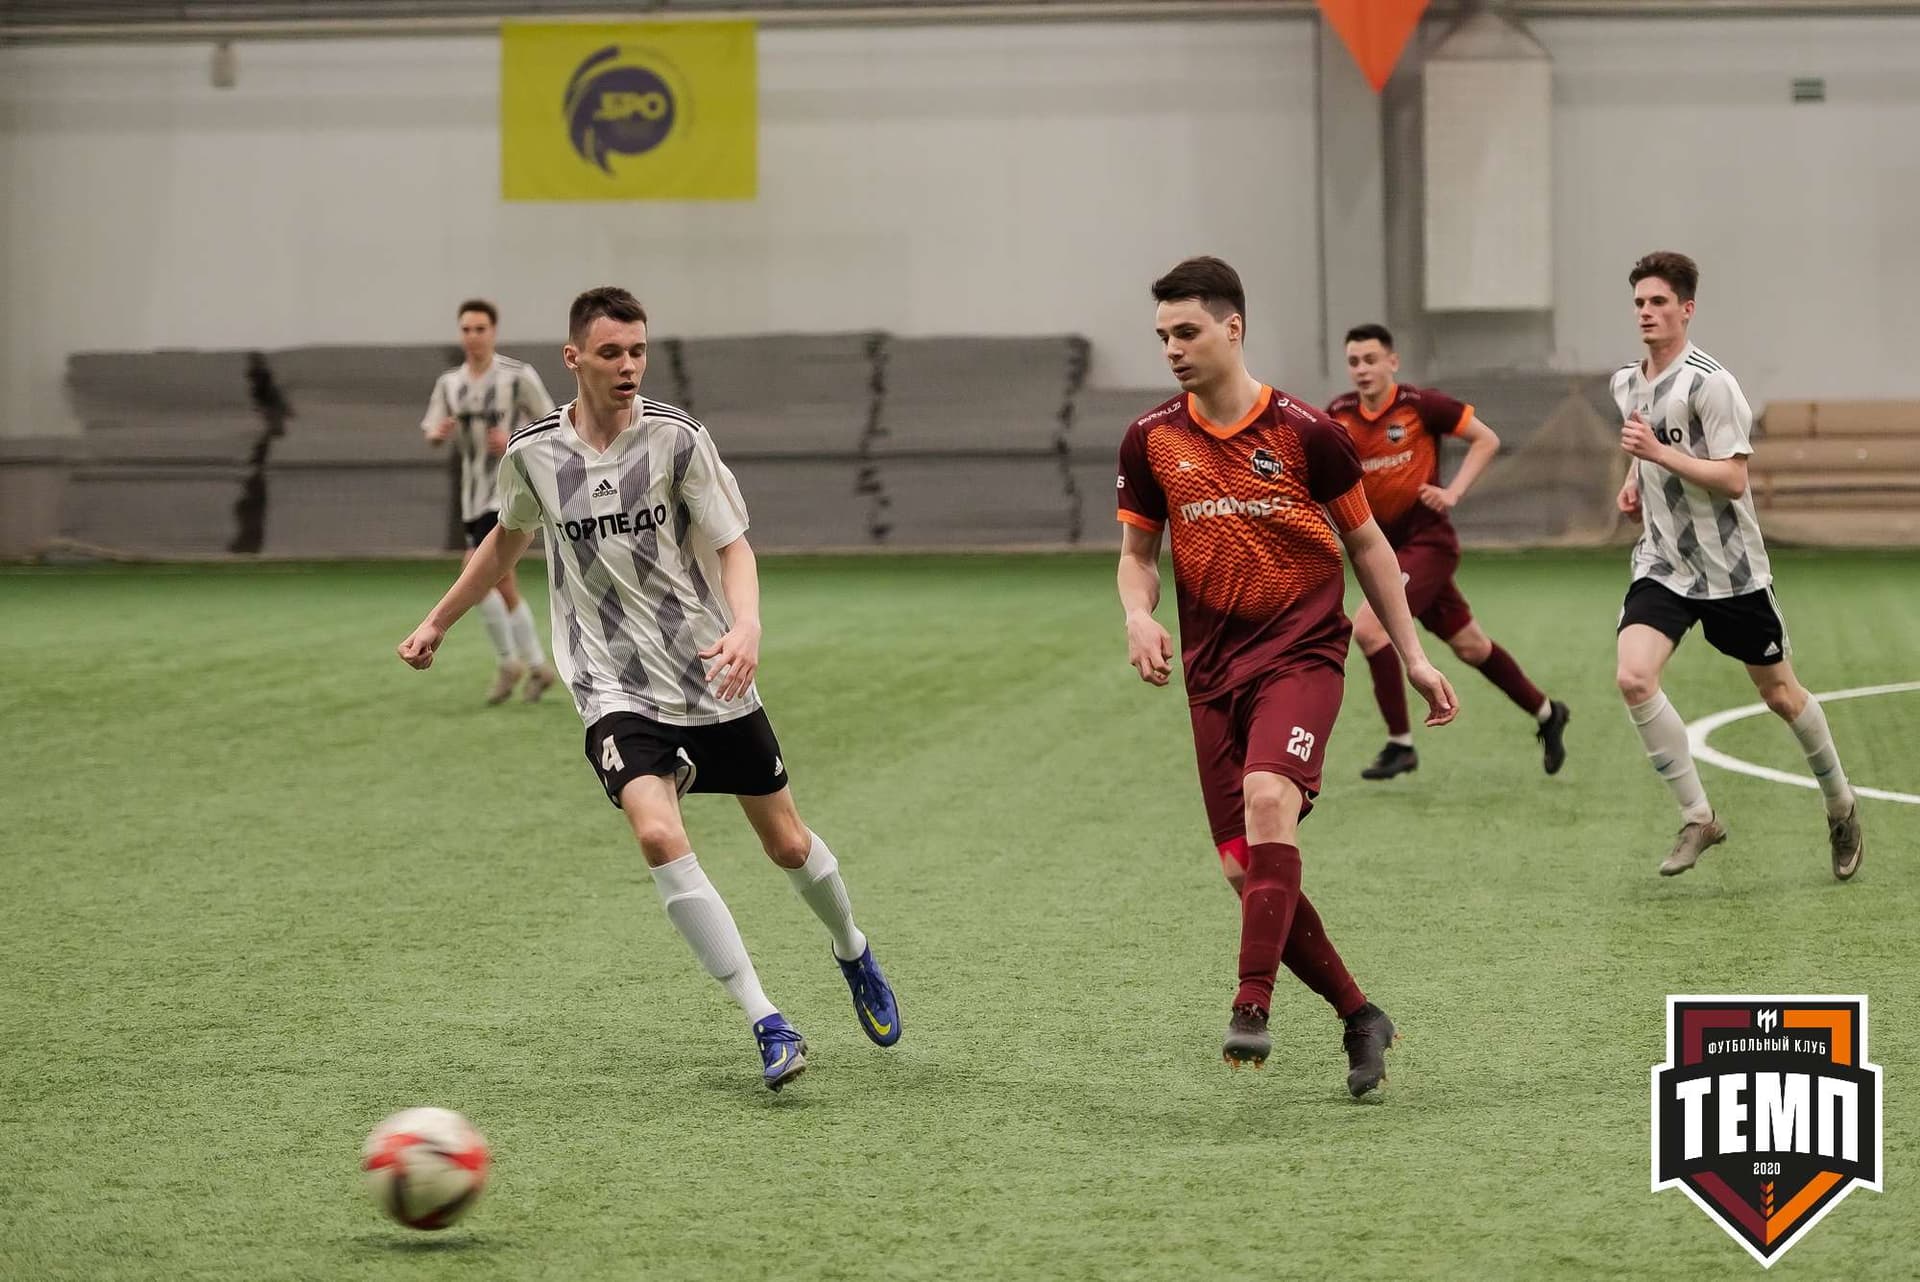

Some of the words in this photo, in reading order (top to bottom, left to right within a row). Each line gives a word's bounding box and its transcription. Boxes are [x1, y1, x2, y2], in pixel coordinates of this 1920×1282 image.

[592, 488, 618, 499] adidas
[556, 504, 667, 542] ТОРПЕДО
[602, 734, 625, 773] 4
[1286, 726, 1315, 762] 23
